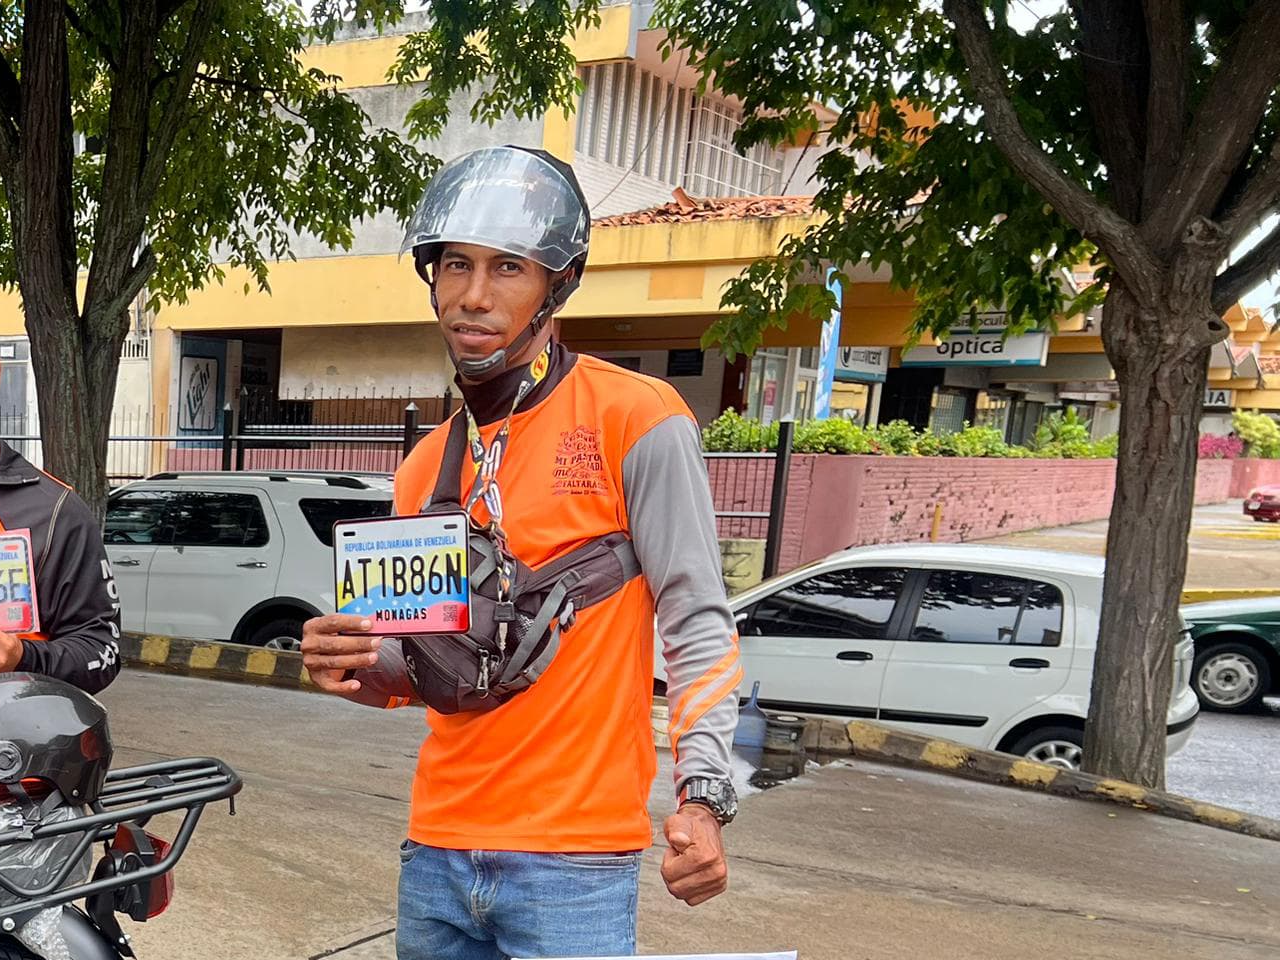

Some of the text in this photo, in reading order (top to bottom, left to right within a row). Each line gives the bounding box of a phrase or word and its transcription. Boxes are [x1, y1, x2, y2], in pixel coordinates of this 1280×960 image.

[1202, 391, 1227, 405] IA
[376, 538, 414, 550] BOLIVARIANA
[415, 538, 423, 547] DE
[424, 536, 457, 547] VENEZUELA
[342, 553, 462, 599] AT1B86N
[376, 607, 427, 621] MONAGAS
